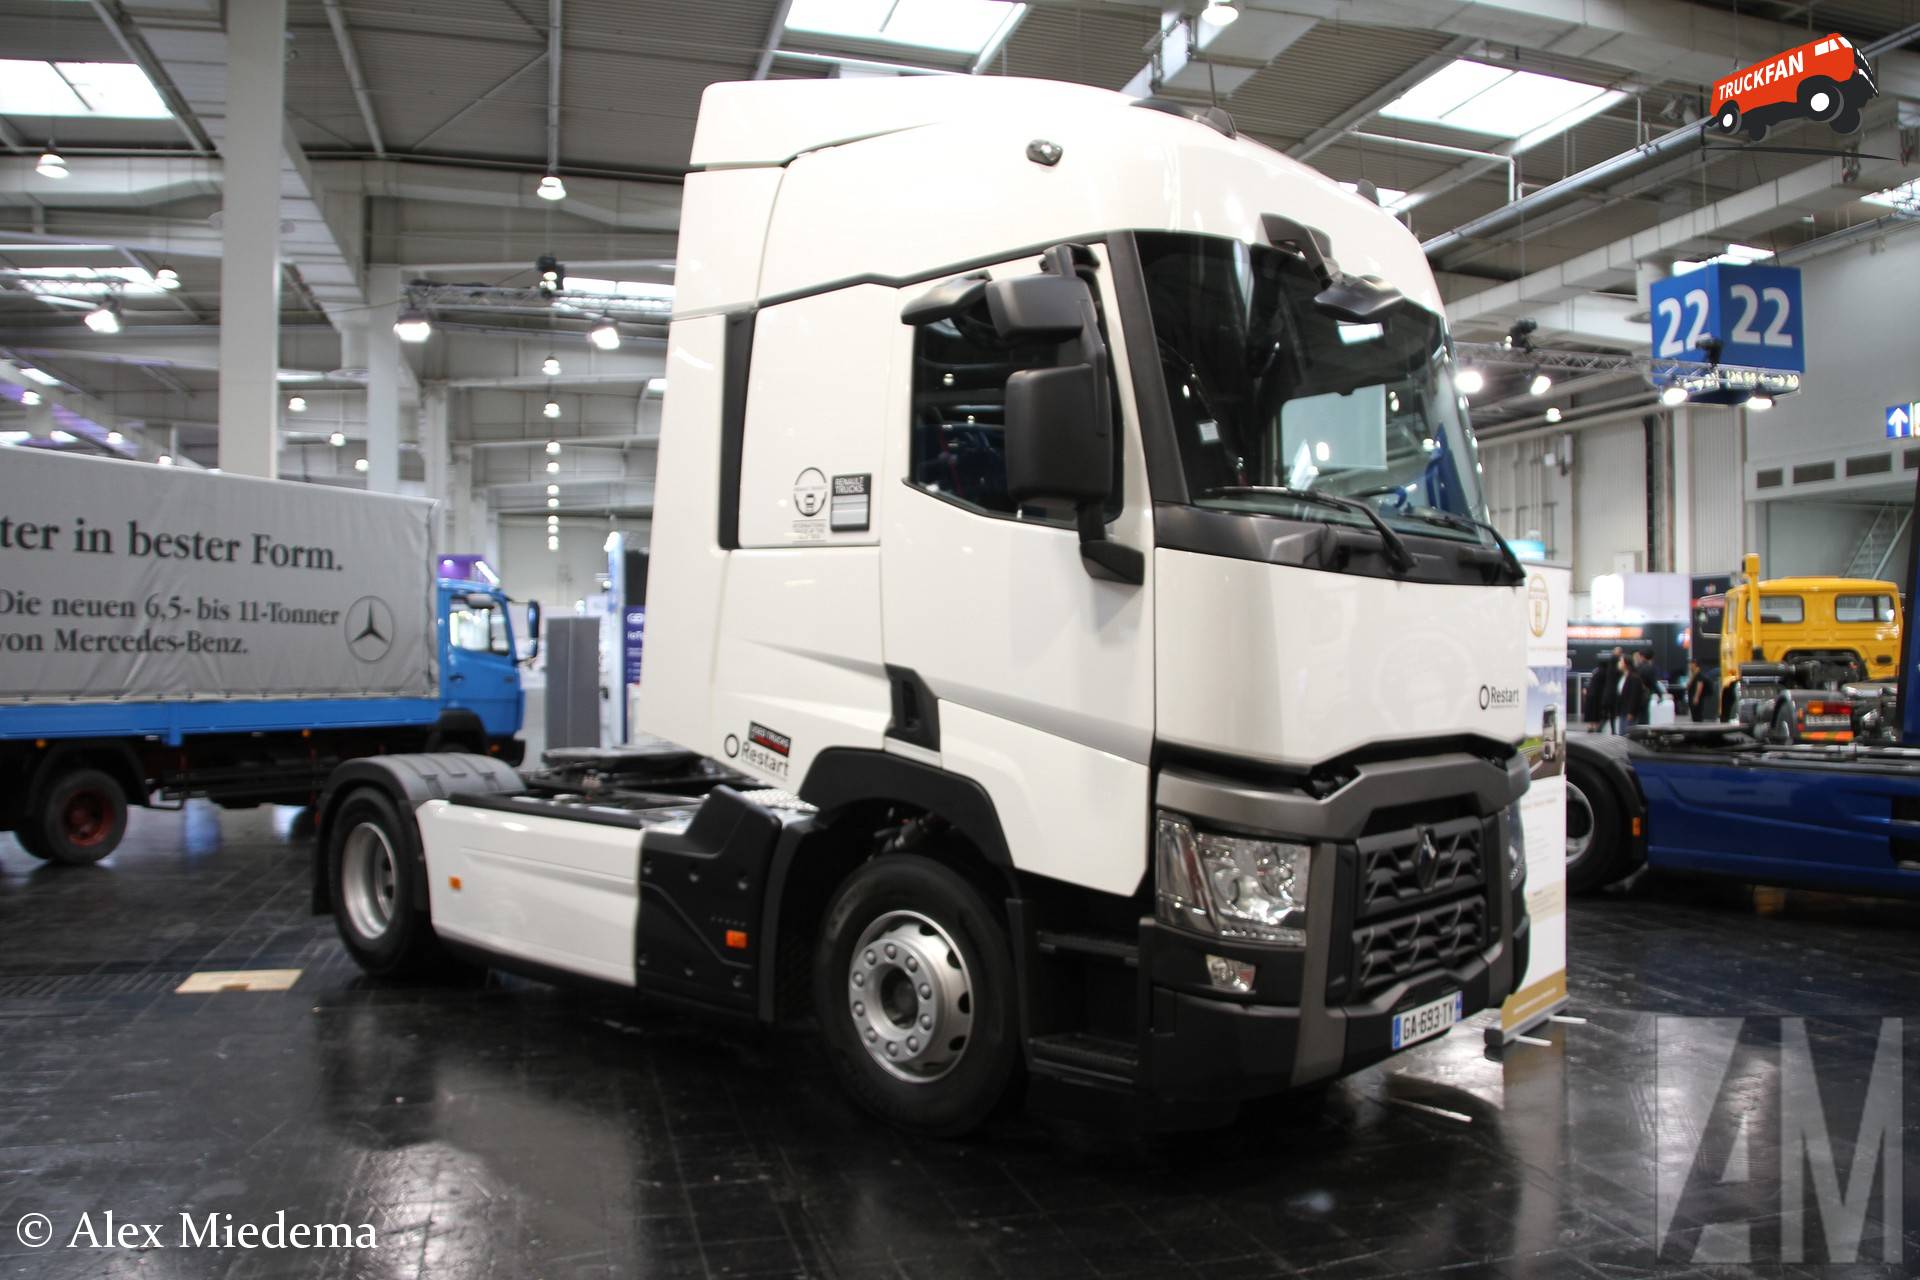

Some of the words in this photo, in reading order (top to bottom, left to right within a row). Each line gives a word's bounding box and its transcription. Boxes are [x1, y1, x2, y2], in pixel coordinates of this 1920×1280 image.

[1658, 288, 1712, 358] 22
[1730, 283, 1793, 348] 22
[835, 476, 865, 487] RENAULT
[835, 484, 865, 495] TRUCKS
[74, 517, 114, 554] in
[128, 519, 241, 563] bester
[252, 532, 344, 572] Form.
[52, 598, 136, 618] neuen
[197, 596, 231, 621] bis
[239, 600, 341, 625] 11-Tonner
[54, 627, 249, 654] Mercedes-Benz.
[1490, 686, 1519, 704] Restart
[741, 740, 789, 776] Restart
